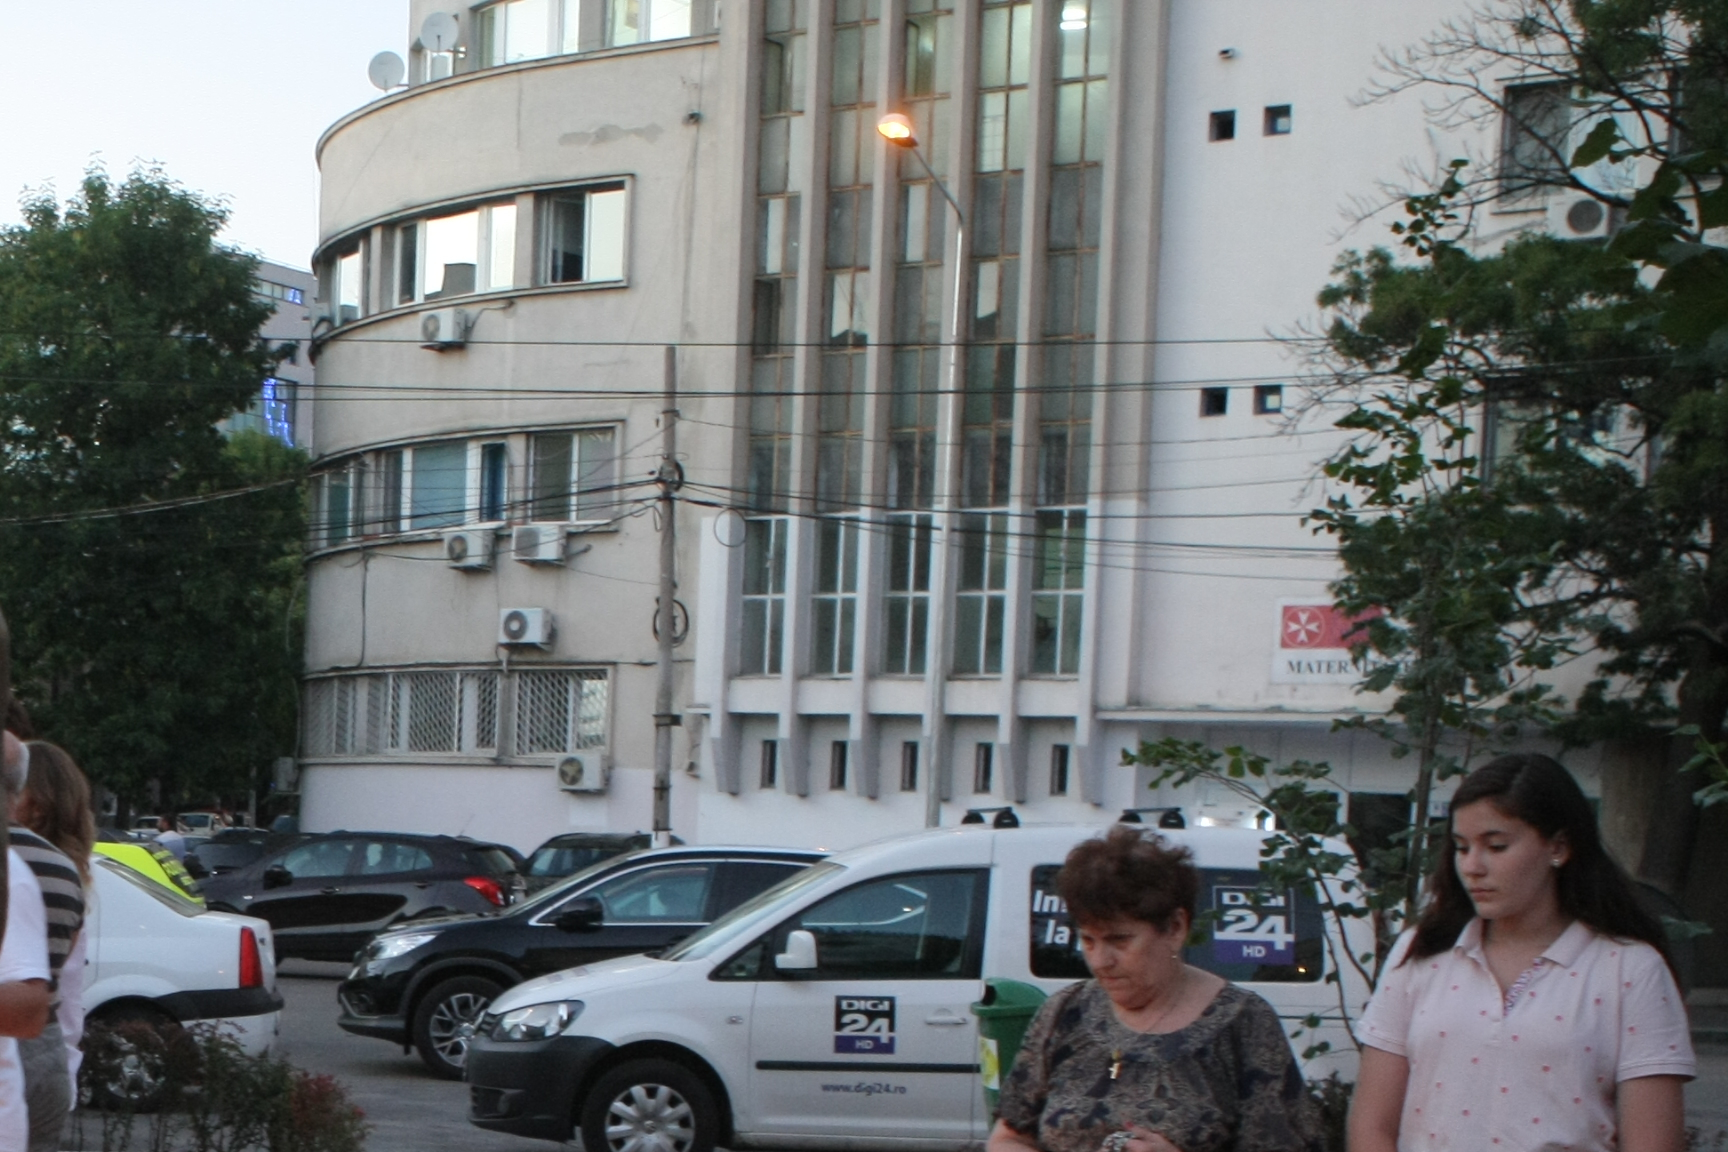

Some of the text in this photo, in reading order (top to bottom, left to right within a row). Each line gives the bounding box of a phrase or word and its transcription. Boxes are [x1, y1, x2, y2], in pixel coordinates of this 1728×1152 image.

[1220, 908, 1294, 951] 24
[1241, 944, 1267, 959] HD
[839, 998, 891, 1012] DIGI
[839, 1012, 891, 1045] 24
[854, 1039, 875, 1051] HD
[821, 1081, 908, 1097] www.digi24.ro
